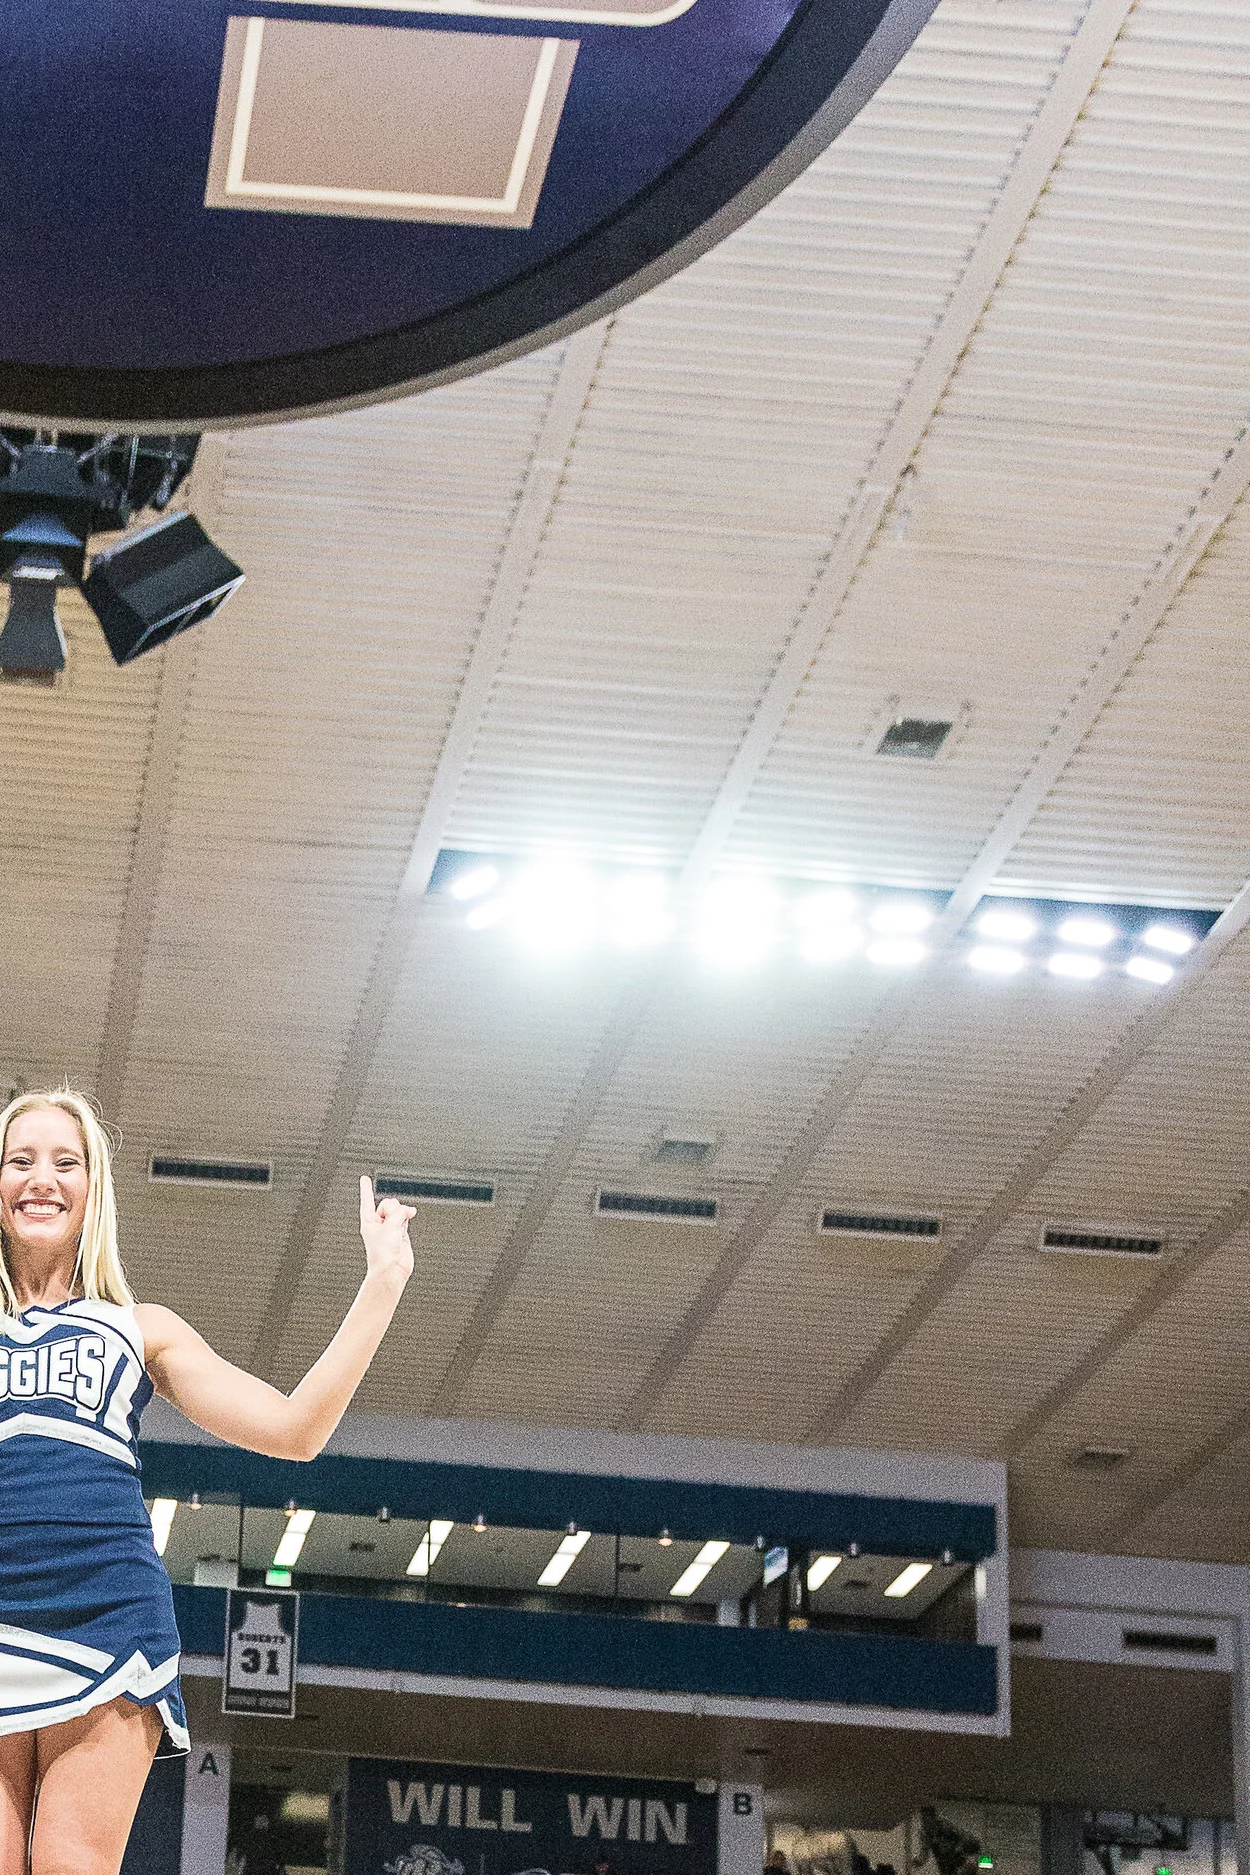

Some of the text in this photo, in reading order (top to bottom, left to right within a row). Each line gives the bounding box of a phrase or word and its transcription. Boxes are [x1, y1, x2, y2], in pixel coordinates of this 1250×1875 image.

[240, 1648, 279, 1676] 31
[198, 1752, 219, 1776] A
[387, 1779, 689, 1845] WILL WIN
[733, 1793, 751, 1815] B
